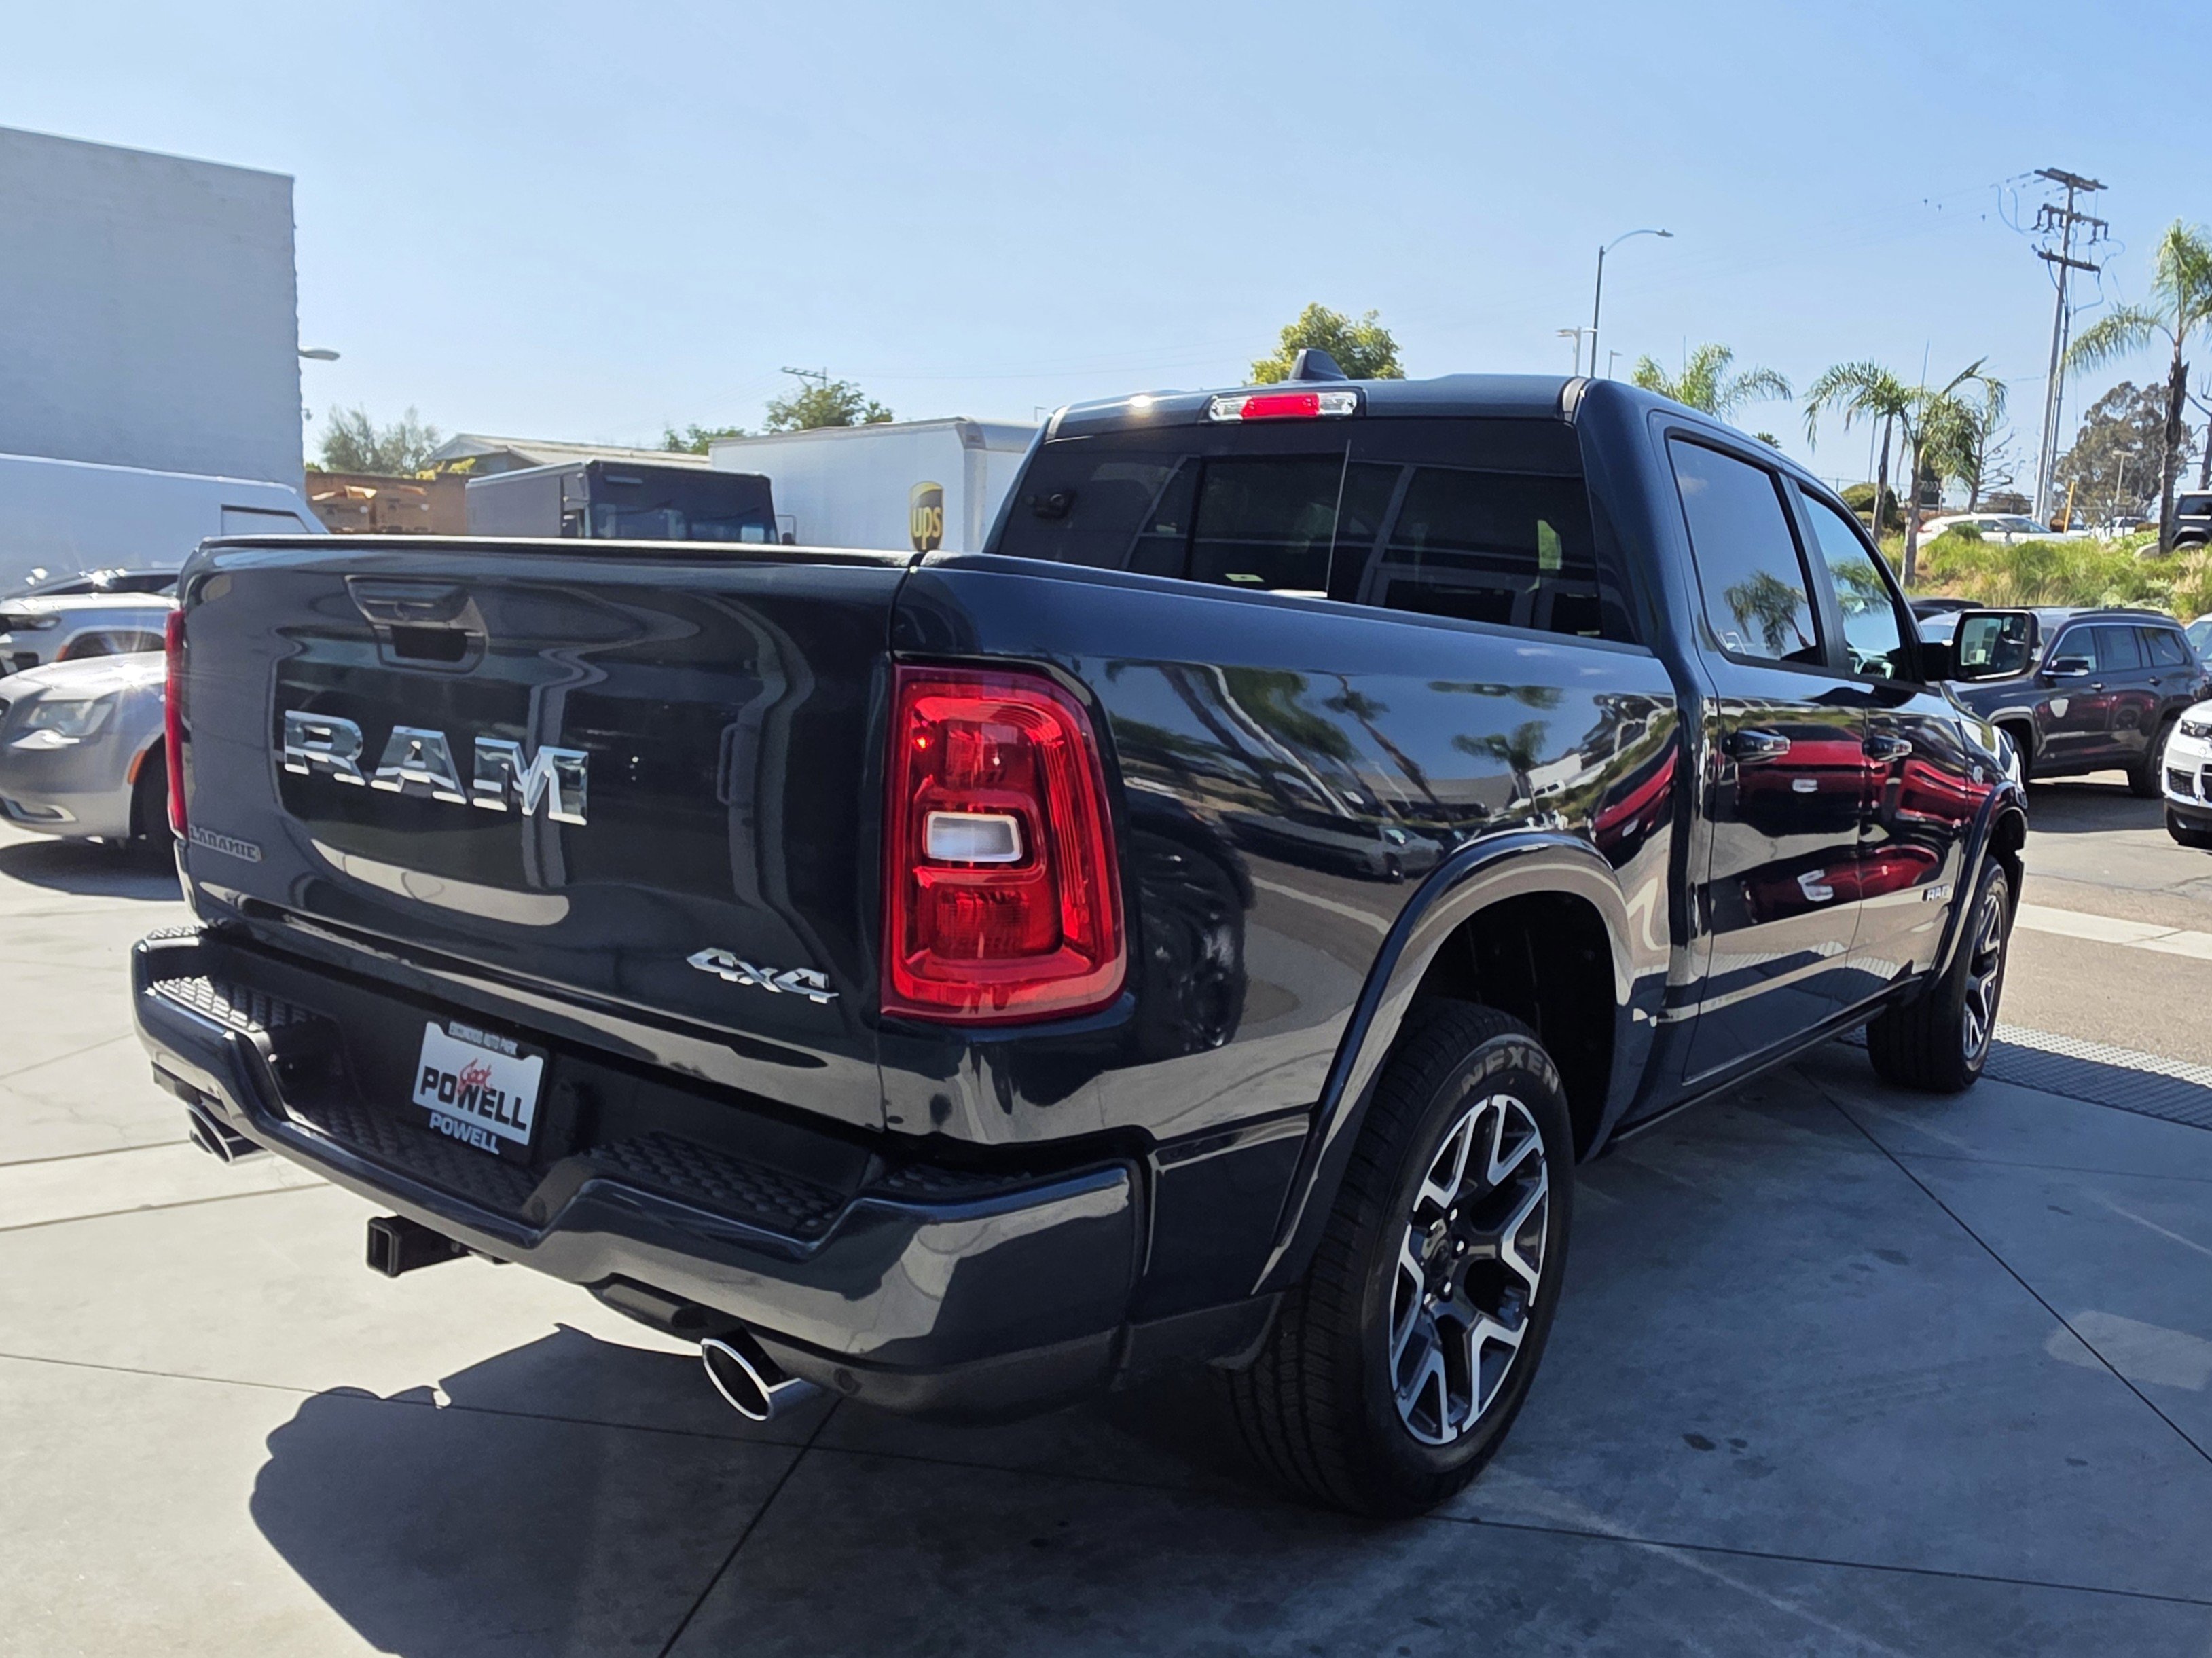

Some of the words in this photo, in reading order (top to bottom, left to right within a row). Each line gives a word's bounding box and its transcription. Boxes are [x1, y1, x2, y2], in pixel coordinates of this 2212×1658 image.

[913, 506, 941, 550] ups
[284, 710, 589, 826] RAM
[189, 824, 261, 862] LARAMIE
[1461, 1046, 1559, 1095] NEXEN
[420, 1066, 527, 1131] POWELL
[429, 1112, 500, 1155] POWELL
